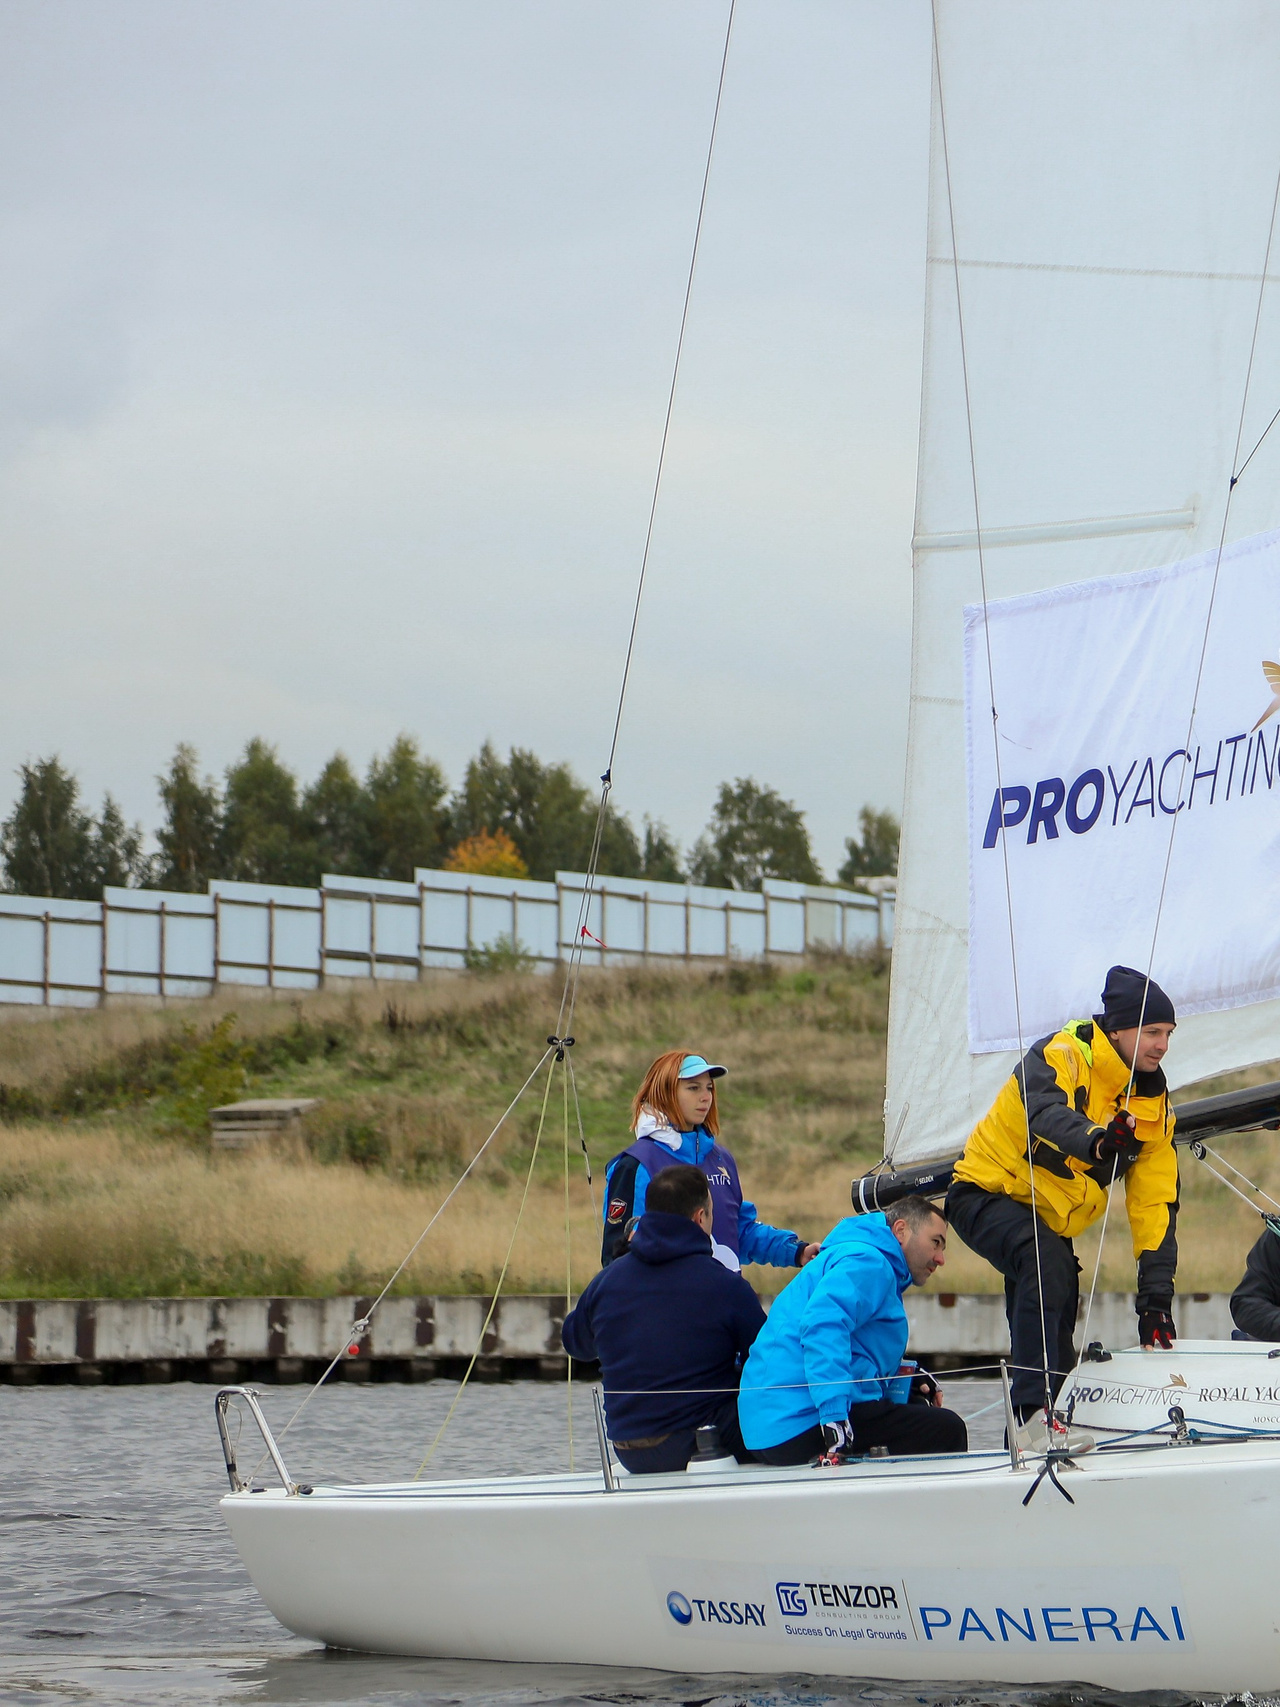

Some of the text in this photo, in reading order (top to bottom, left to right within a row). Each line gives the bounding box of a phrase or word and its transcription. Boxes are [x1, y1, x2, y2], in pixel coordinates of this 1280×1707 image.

[1065, 1387, 1184, 1407] PROYACHTING
[1198, 1387, 1250, 1402] ROYAL
[804, 1583, 899, 1609] TENZOR
[692, 1599, 767, 1627] TASSAY
[815, 1611, 868, 1620] CONSULTING
[784, 1624, 908, 1641] Success On Legal Grounds
[919, 1605, 1186, 1642] PANERAI
